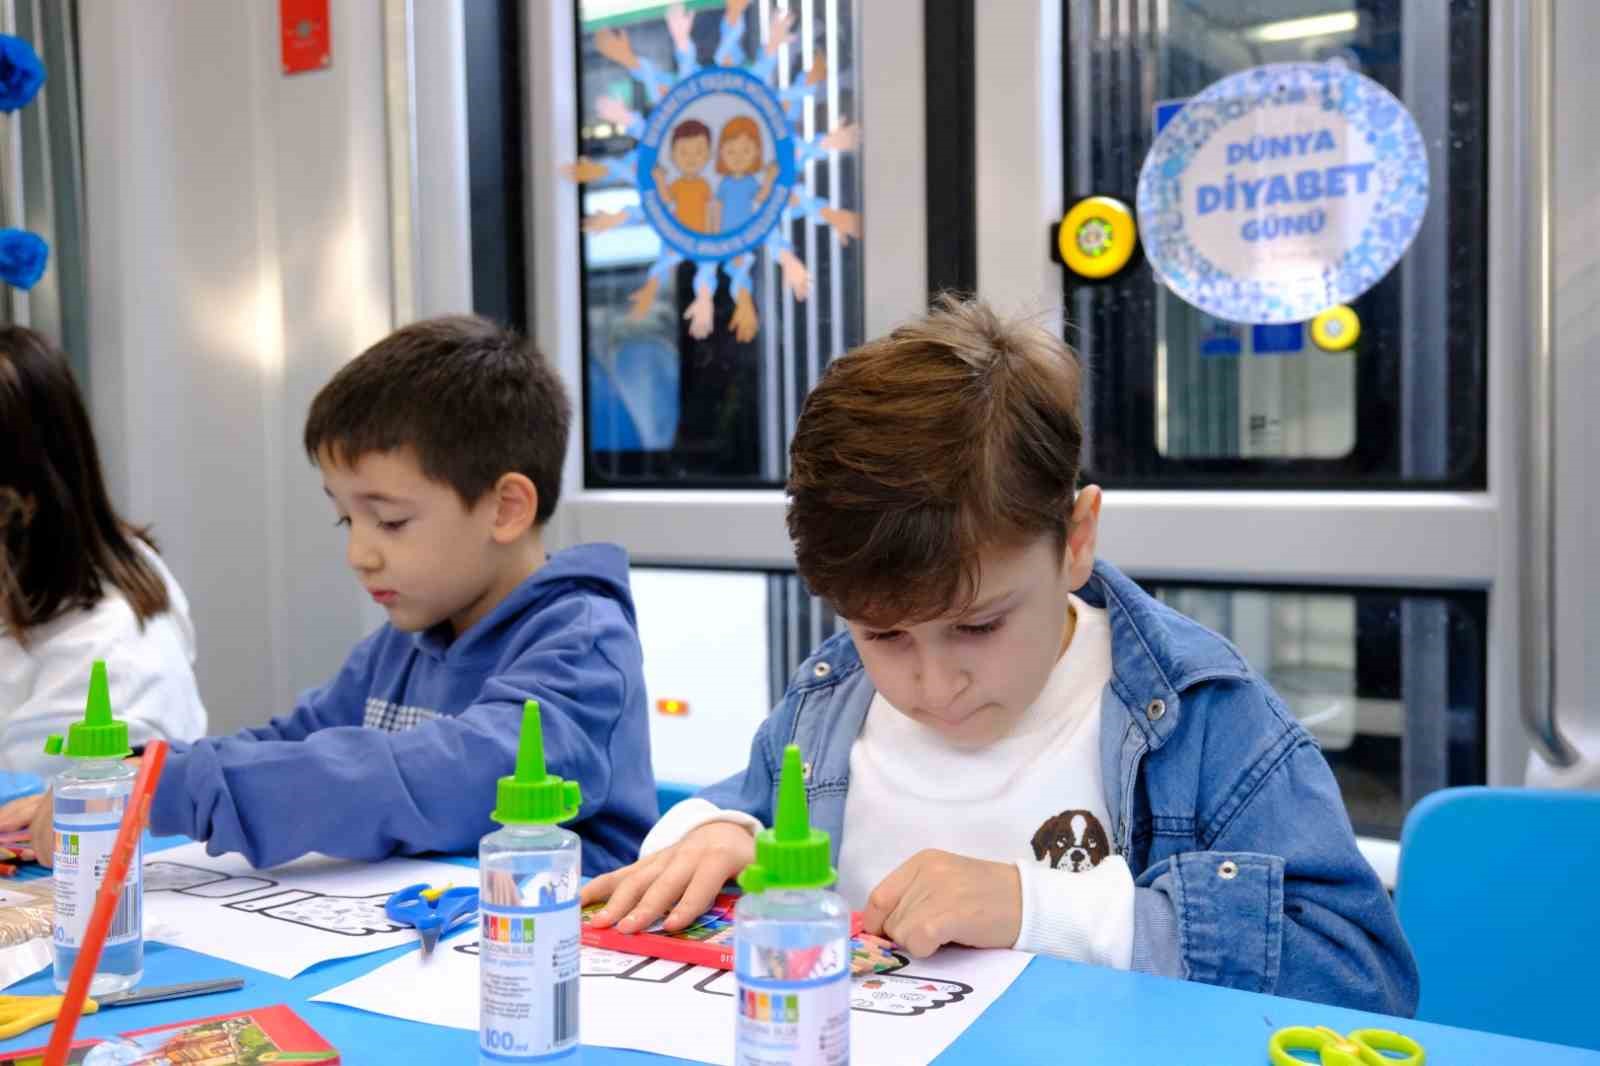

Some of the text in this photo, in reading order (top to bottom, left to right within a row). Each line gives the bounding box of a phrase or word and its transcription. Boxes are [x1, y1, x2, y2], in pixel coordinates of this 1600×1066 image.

[1226, 128, 1336, 165] DÜNYA
[1196, 163, 1376, 216] DİYABET
[1241, 208, 1326, 241] GÜNÜ
[485, 1027, 514, 1050] 100
